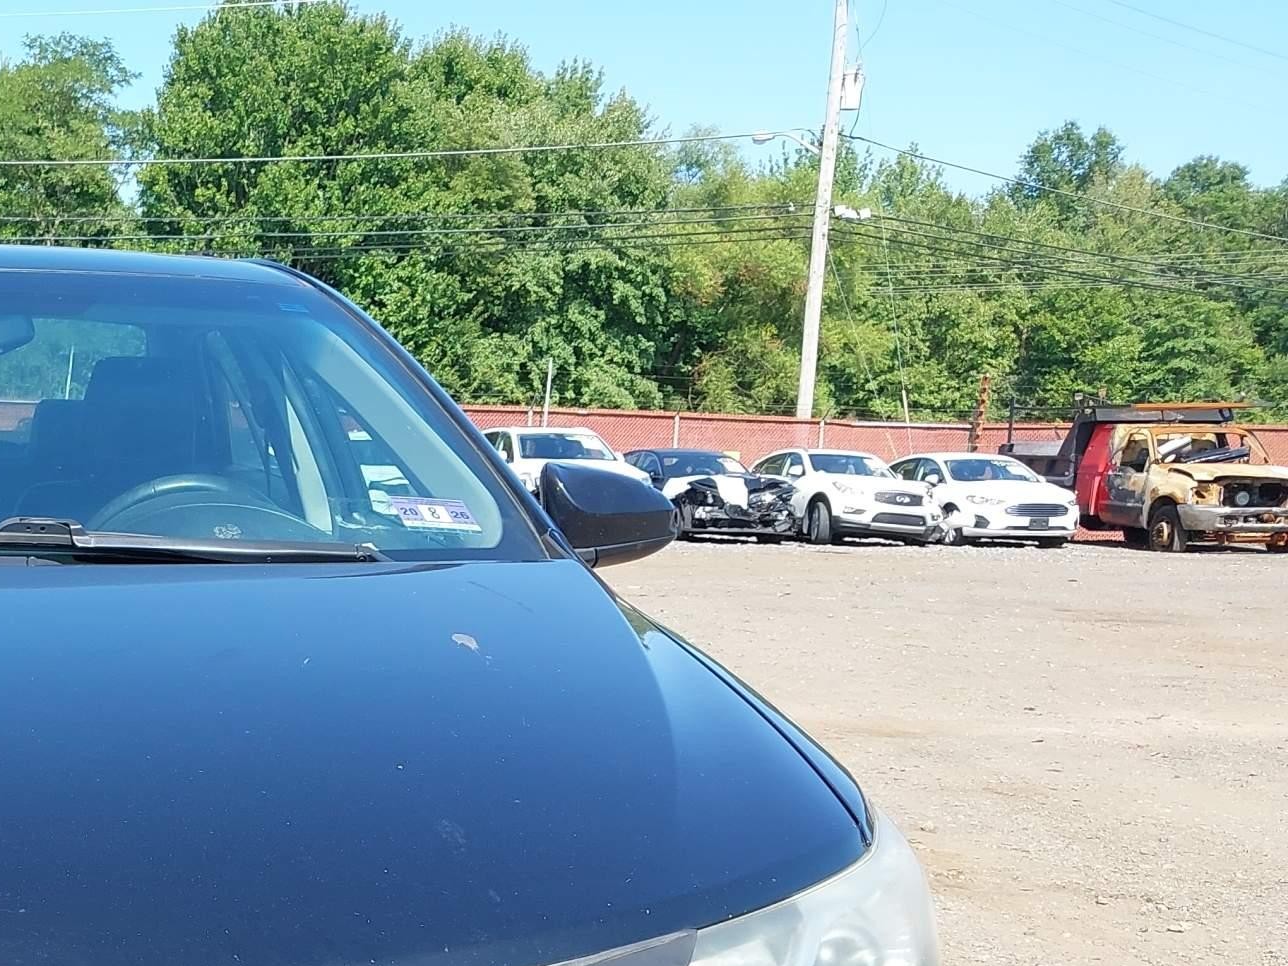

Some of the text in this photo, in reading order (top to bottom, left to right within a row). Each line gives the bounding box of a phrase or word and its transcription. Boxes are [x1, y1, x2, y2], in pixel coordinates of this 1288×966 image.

[399, 506, 470, 520] 20 8 26
